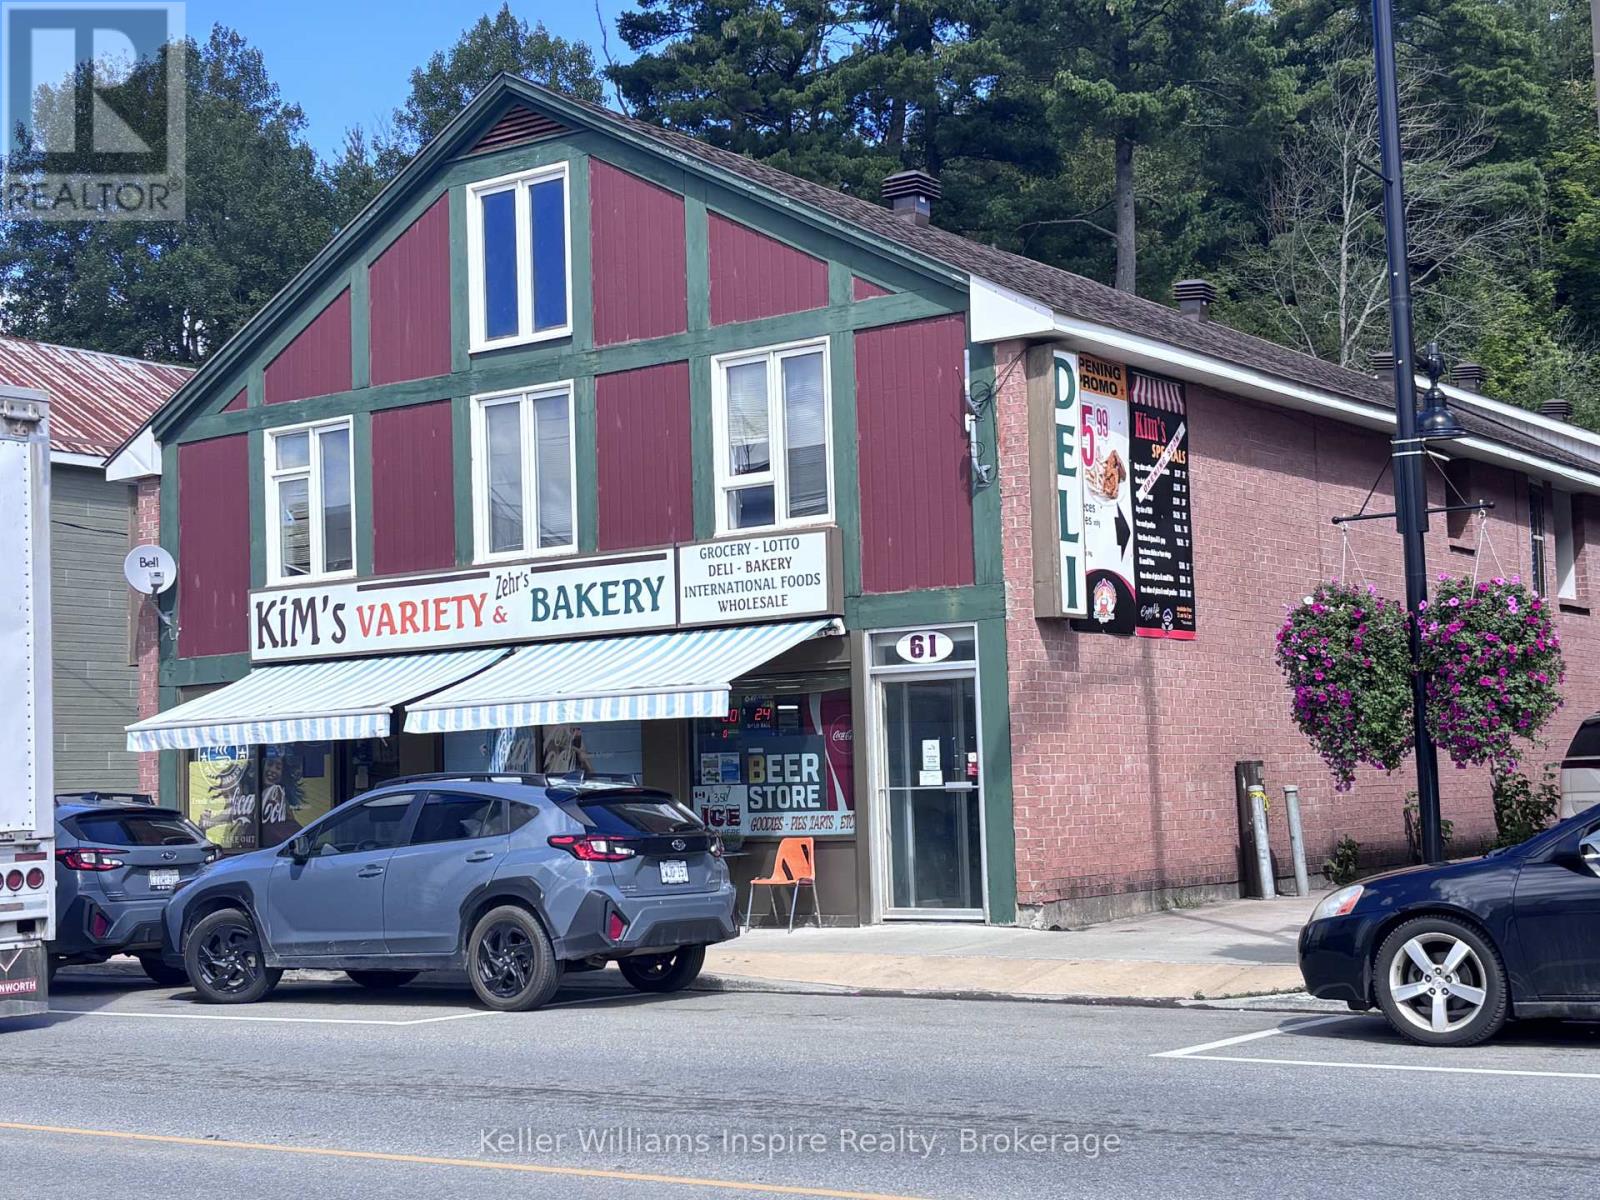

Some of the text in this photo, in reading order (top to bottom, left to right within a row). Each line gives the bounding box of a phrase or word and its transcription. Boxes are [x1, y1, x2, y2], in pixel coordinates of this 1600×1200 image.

[1080, 359, 1121, 380] PENING
[1134, 411, 1167, 443] Kim's
[1151, 443, 1187, 465] SPEIALS
[1053, 356, 1080, 609] DELI
[1143, 456, 1167, 493] OPENING
[699, 541, 752, 560] GROCERY
[762, 537, 800, 552] LOTTO
[139, 556, 159, 568] Bell
[708, 561, 734, 577] DELI
[745, 556, 793, 573] BAKERY
[495, 573, 530, 601] Zehr's
[684, 572, 821, 598] INTERNATIONAL FOODS
[356, 592, 489, 638] VARIETY
[493, 605, 508, 624] &
[530, 575, 665, 622] BAKERY
[717, 593, 789, 613] WHOLESALE
[909, 633, 937, 659] 61
[754, 707, 771, 721] 24
[749, 753, 820, 784] BEER
[749, 784, 821, 810] STORE
[701, 804, 741, 828] ICE
[750, 816, 784, 833] GOODIES
